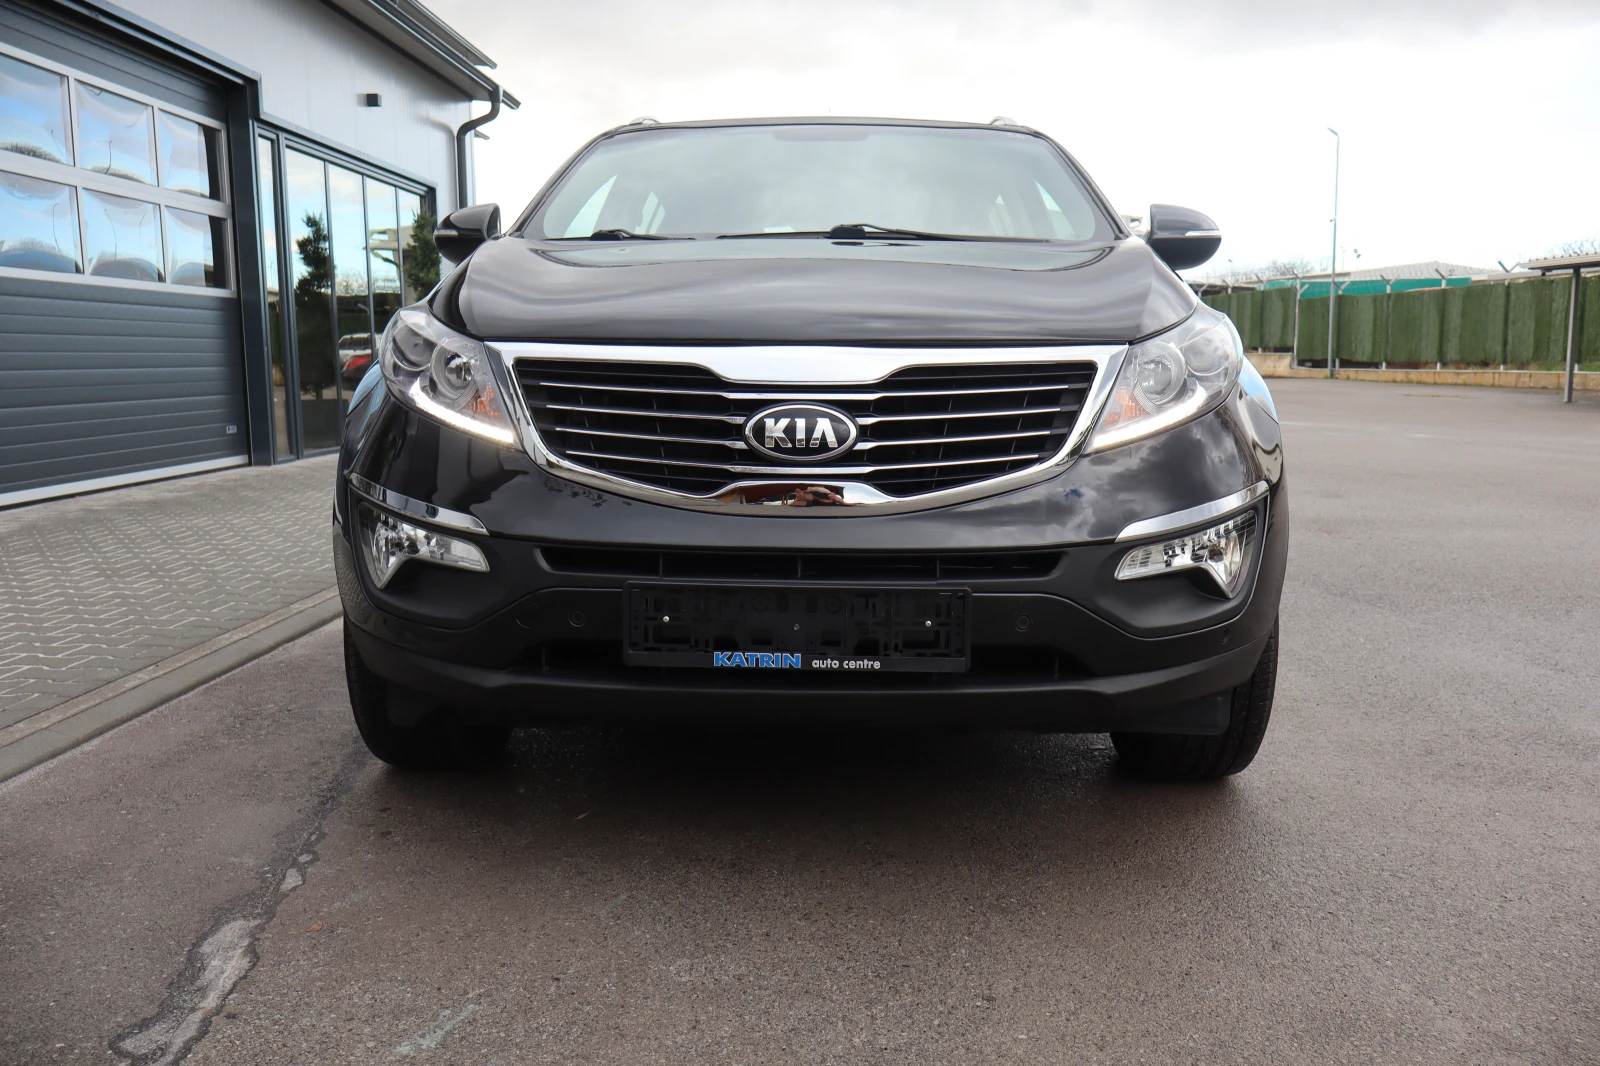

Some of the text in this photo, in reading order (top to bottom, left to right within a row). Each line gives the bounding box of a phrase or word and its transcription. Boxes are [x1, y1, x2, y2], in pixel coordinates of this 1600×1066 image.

[764, 418, 838, 447] KIA
[714, 652, 881, 669] KATRIN auto centre
